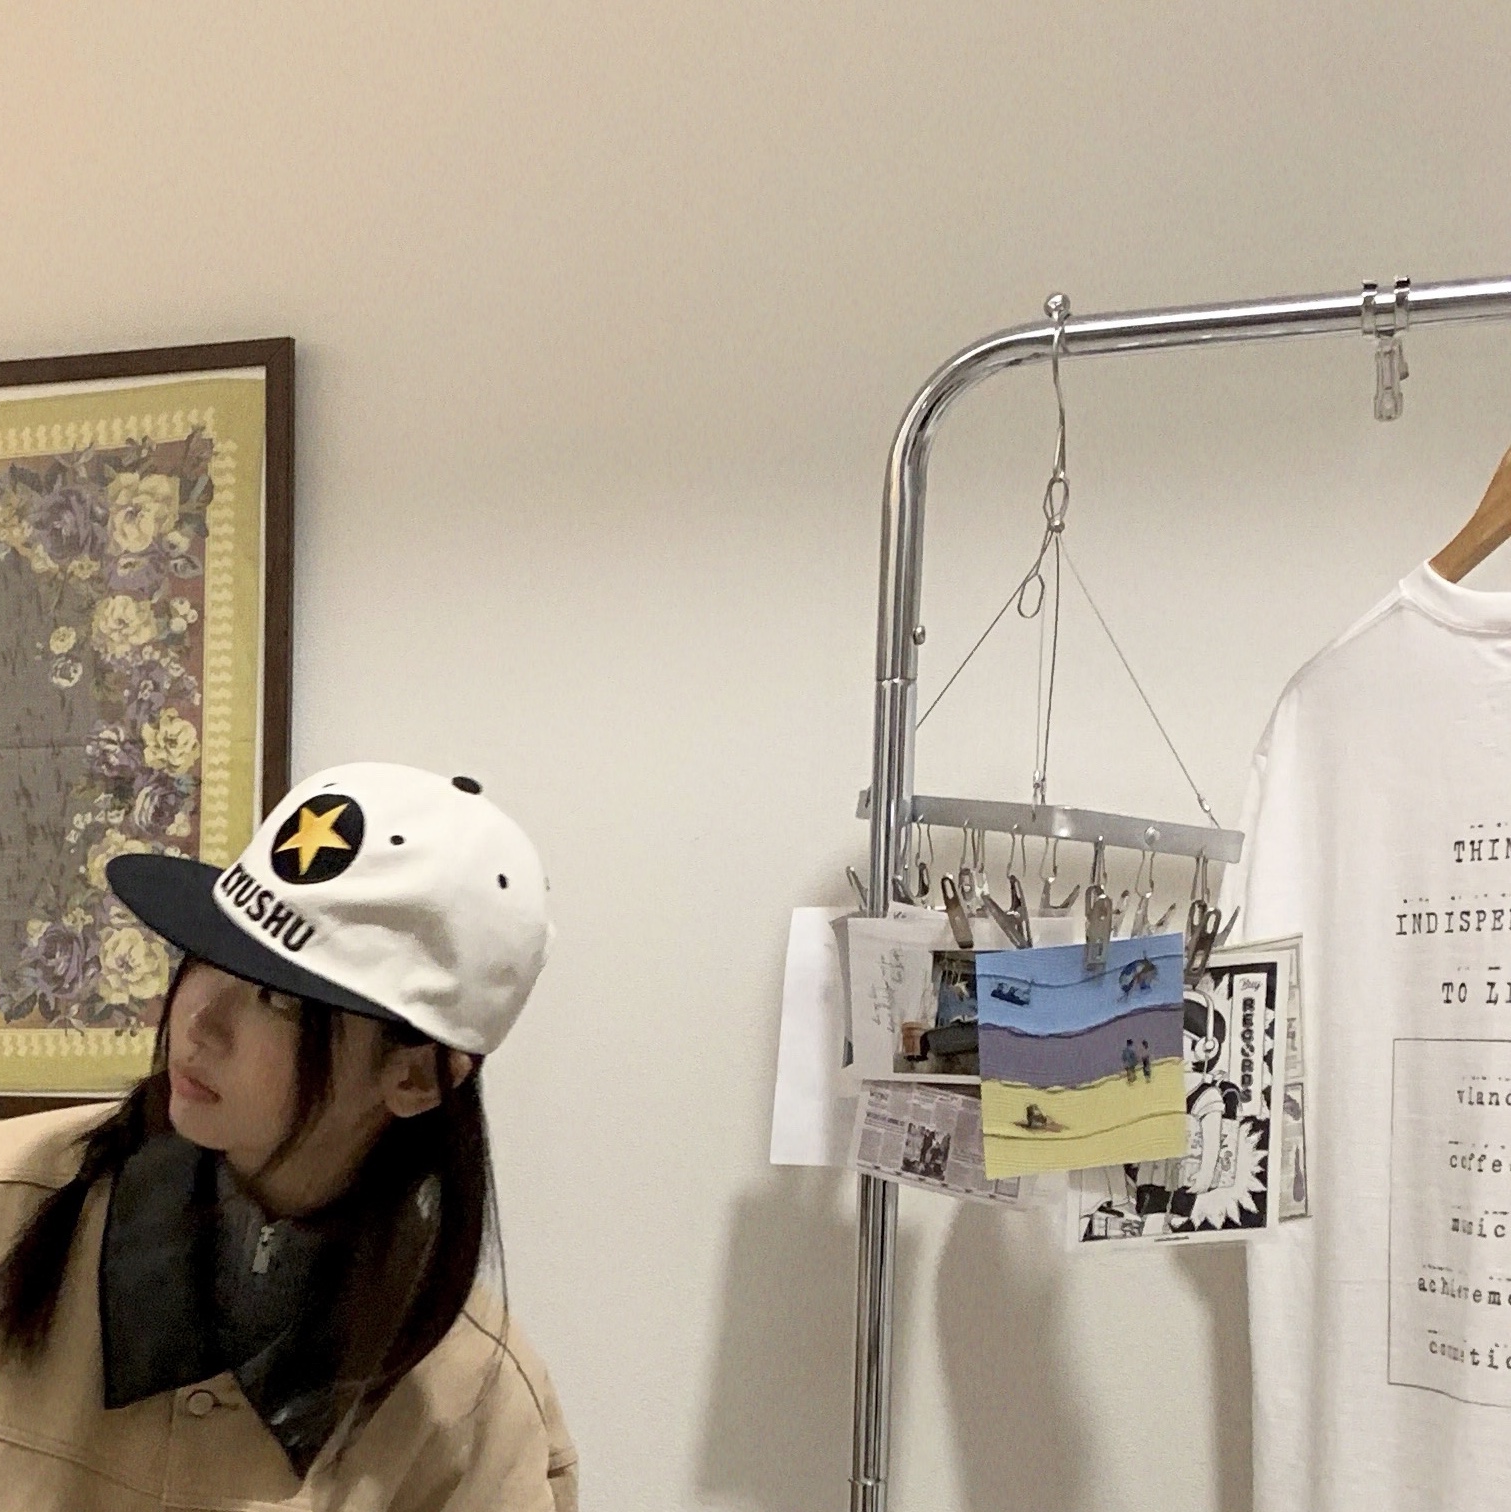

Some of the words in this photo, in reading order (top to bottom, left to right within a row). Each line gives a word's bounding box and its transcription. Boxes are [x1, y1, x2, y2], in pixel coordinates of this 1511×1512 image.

[1395, 908, 1511, 936] INDISPE
[1441, 981, 1468, 1004] TO
[1240, 997, 1256, 1103] RECORDS
[1450, 1152, 1511, 1173] coffe
